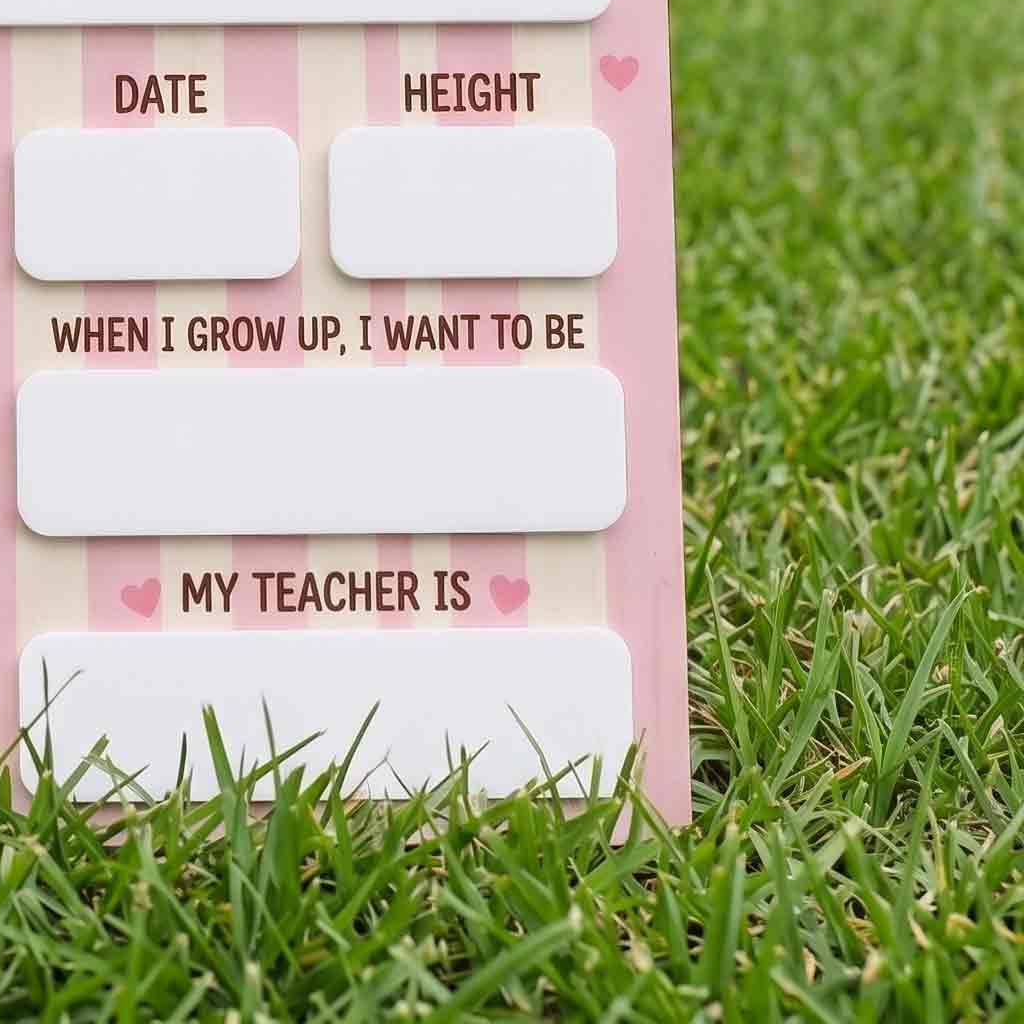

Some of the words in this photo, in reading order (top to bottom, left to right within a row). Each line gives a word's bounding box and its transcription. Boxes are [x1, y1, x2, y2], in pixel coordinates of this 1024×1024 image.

[114, 73, 208, 115] DATE
[403, 71, 541, 114] HEIGHT
[50, 315, 149, 354] WHEN
[160, 315, 176, 353] I
[186, 314, 286, 353] GROW
[297, 314, 347, 357] UP,
[358, 314, 373, 352] I
[382, 313, 482, 352] WANT
[489, 312, 534, 351] TO
[544, 312, 585, 351] BE
[181, 571, 240, 614] MY
[250, 570, 421, 613] TEACHER
[432, 569, 472, 612] IS
